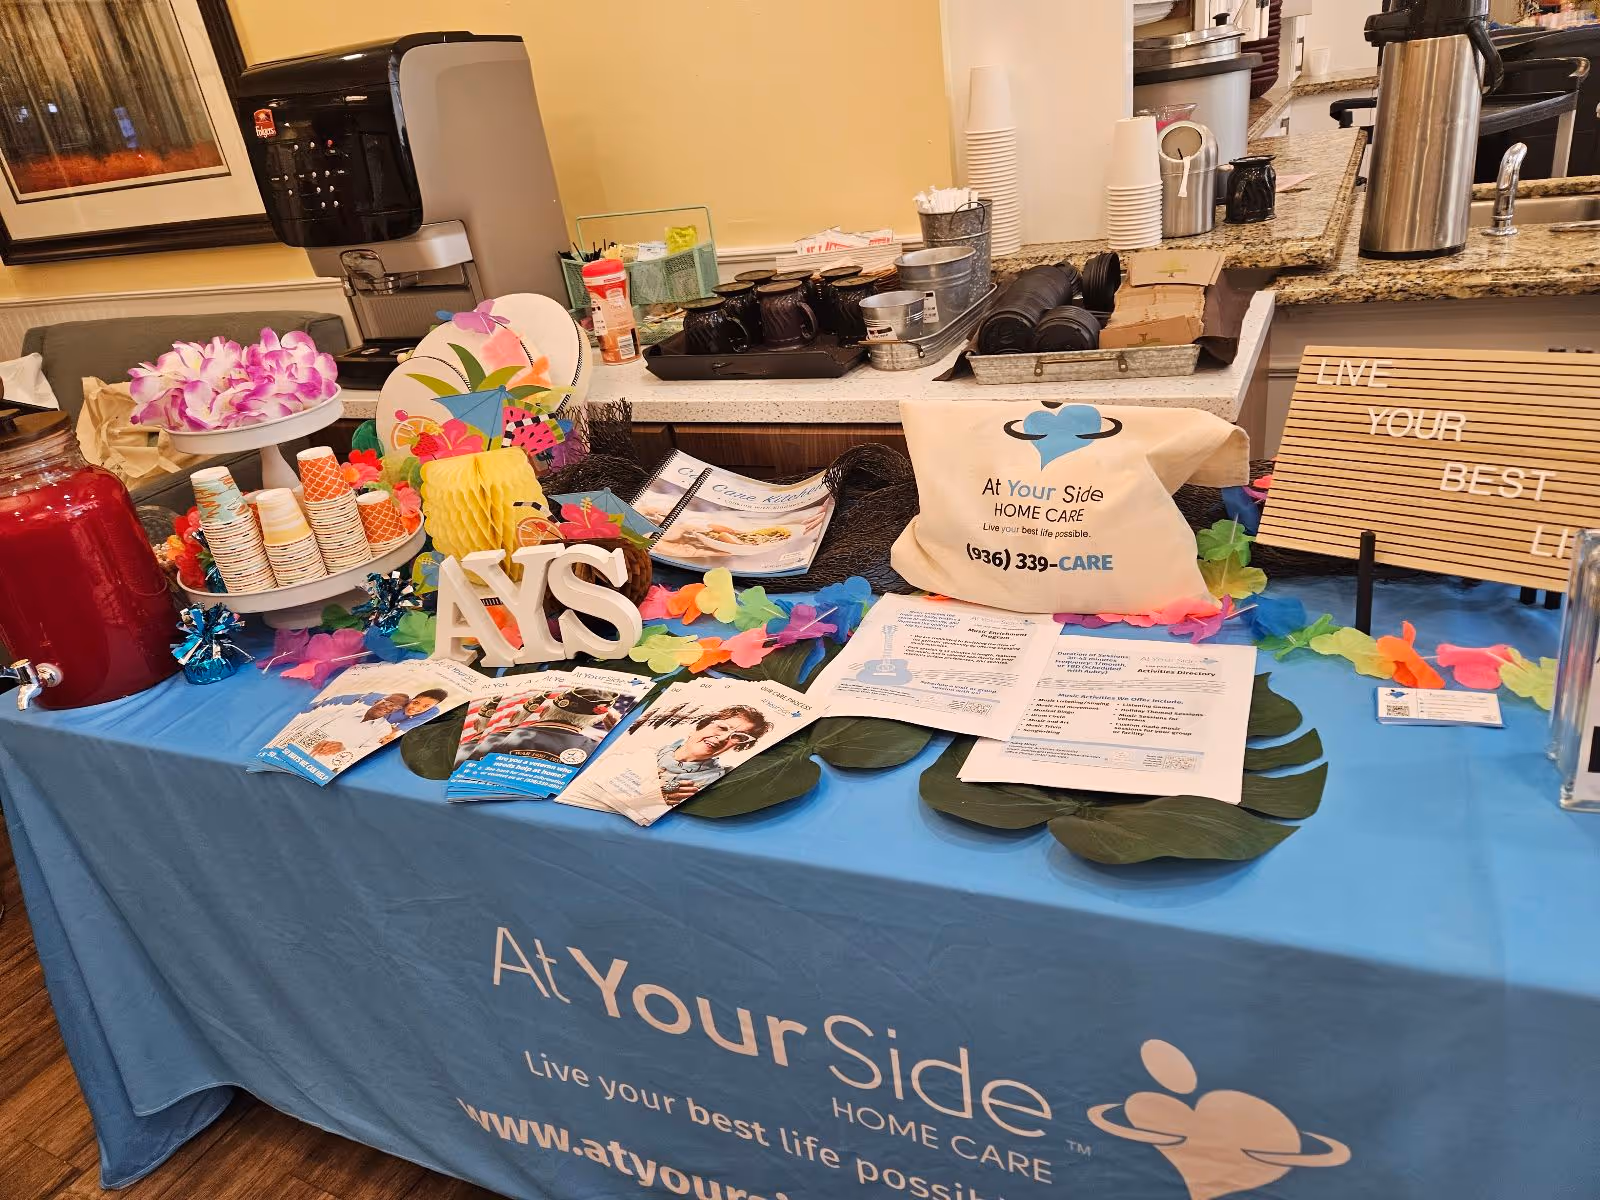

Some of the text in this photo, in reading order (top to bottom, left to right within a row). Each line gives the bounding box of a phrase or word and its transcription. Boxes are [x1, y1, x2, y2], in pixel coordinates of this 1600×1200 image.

[255, 125, 275, 138] Folgers
[1317, 358, 1393, 388] LIVE
[1368, 407, 1466, 442] YOUR
[982, 477, 1104, 504] At Your Side
[1440, 462, 1557, 502] BEST
[994, 503, 1085, 523] HOME CARE
[982, 523, 1092, 540] Live your best life possible.
[1530, 525, 1569, 559] LI
[966, 543, 1114, 573] (936) 339-CARE
[432, 543, 643, 667] AYS
[785, 696, 813, 711] PROCESS
[493, 761, 515, 769] needs
[516, 764, 532, 772] help
[541, 769, 567, 779] home?
[529, 761, 557, 770] veteran
[557, 766, 573, 774] who
[493, 926, 1052, 1138] At Your Side
[524, 1050, 590, 1088] Live
[599, 1075, 676, 1115] your
[686, 1096, 771, 1148] best
[779, 1126, 841, 1170] life
[832, 1097, 940, 1150] HOME
[951, 1135, 1053, 1185] CARE
